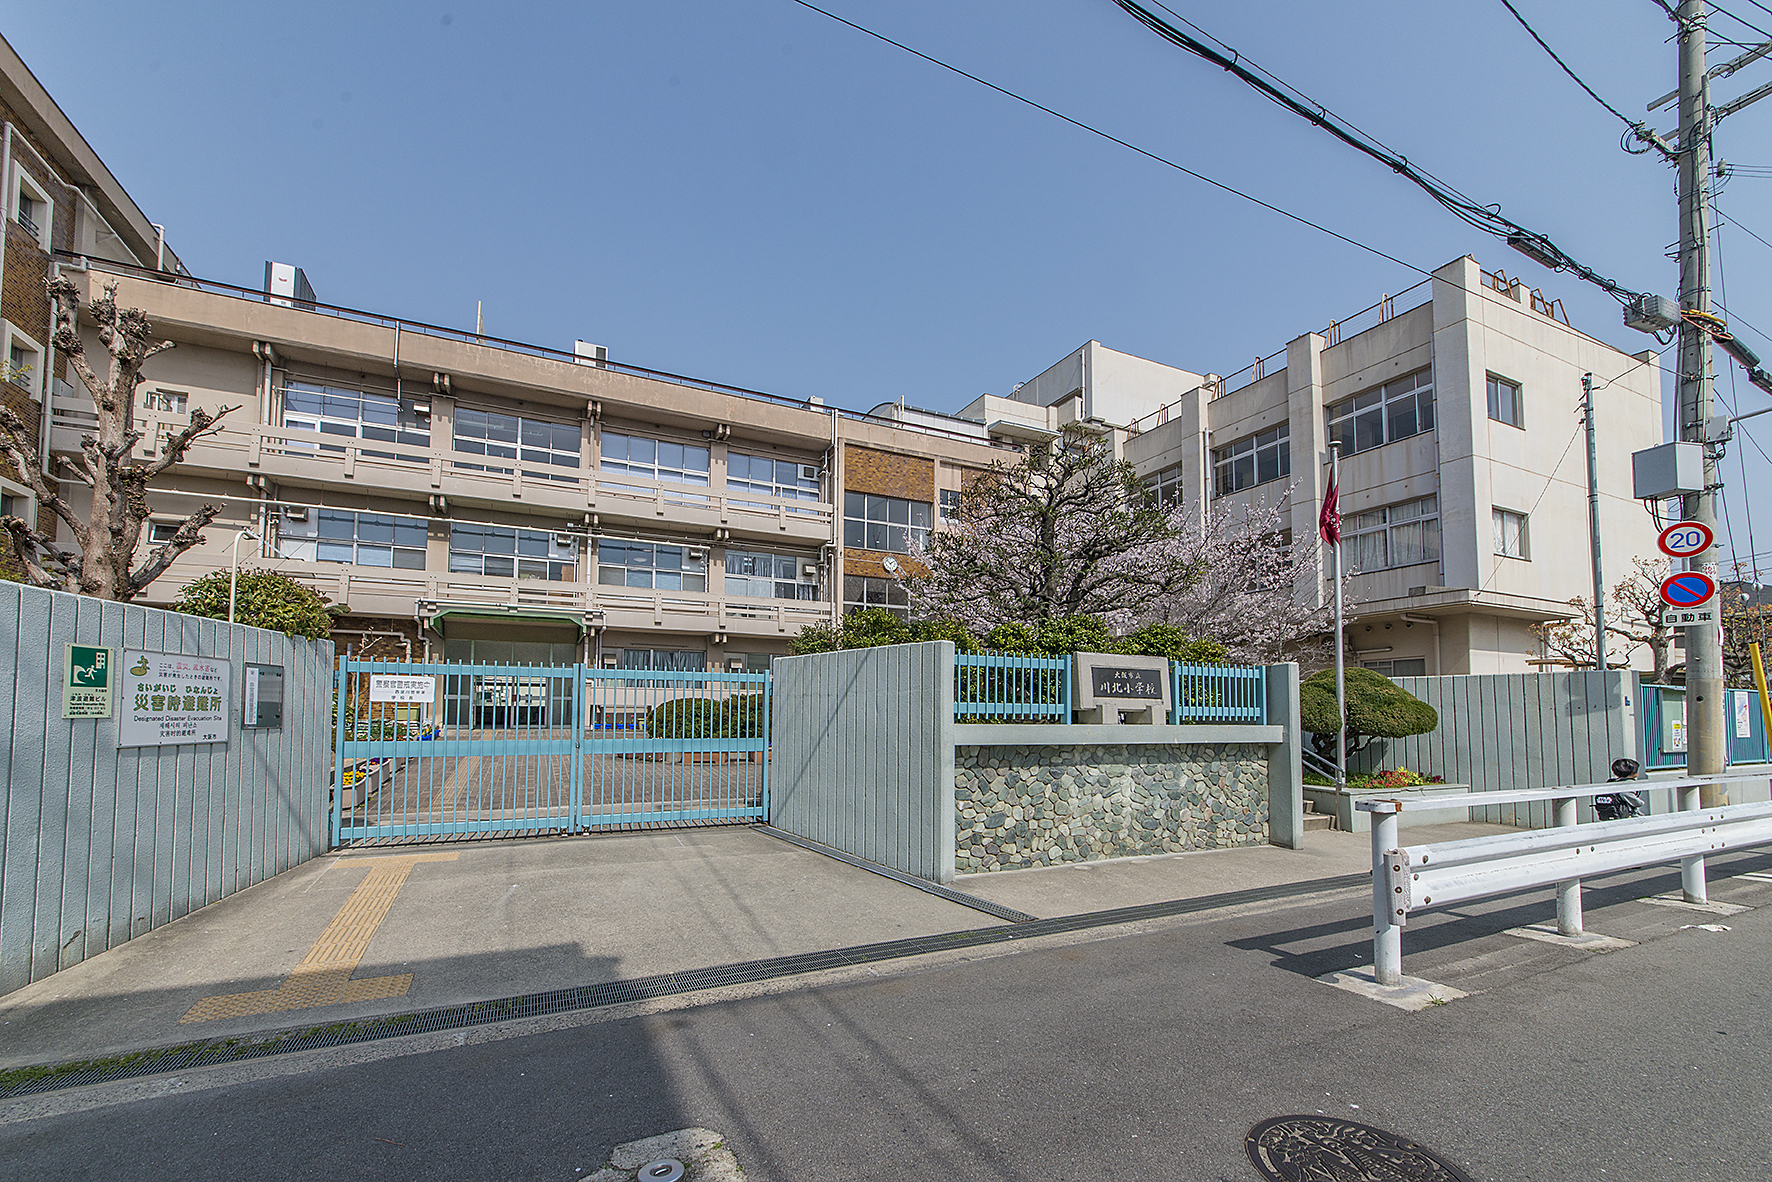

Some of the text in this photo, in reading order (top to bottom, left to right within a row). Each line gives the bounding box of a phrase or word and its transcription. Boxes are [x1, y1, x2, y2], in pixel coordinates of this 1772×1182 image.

[1670, 531, 1700, 548] 20
[1666, 612, 1711, 622] 自動車
[1114, 671, 1142, 679] 大阪市立
[137, 683, 219, 695] さいがいじ ひなんじょ
[1100, 681, 1157, 695] 川北小学校
[133, 694, 222, 712] 災害時避難所
